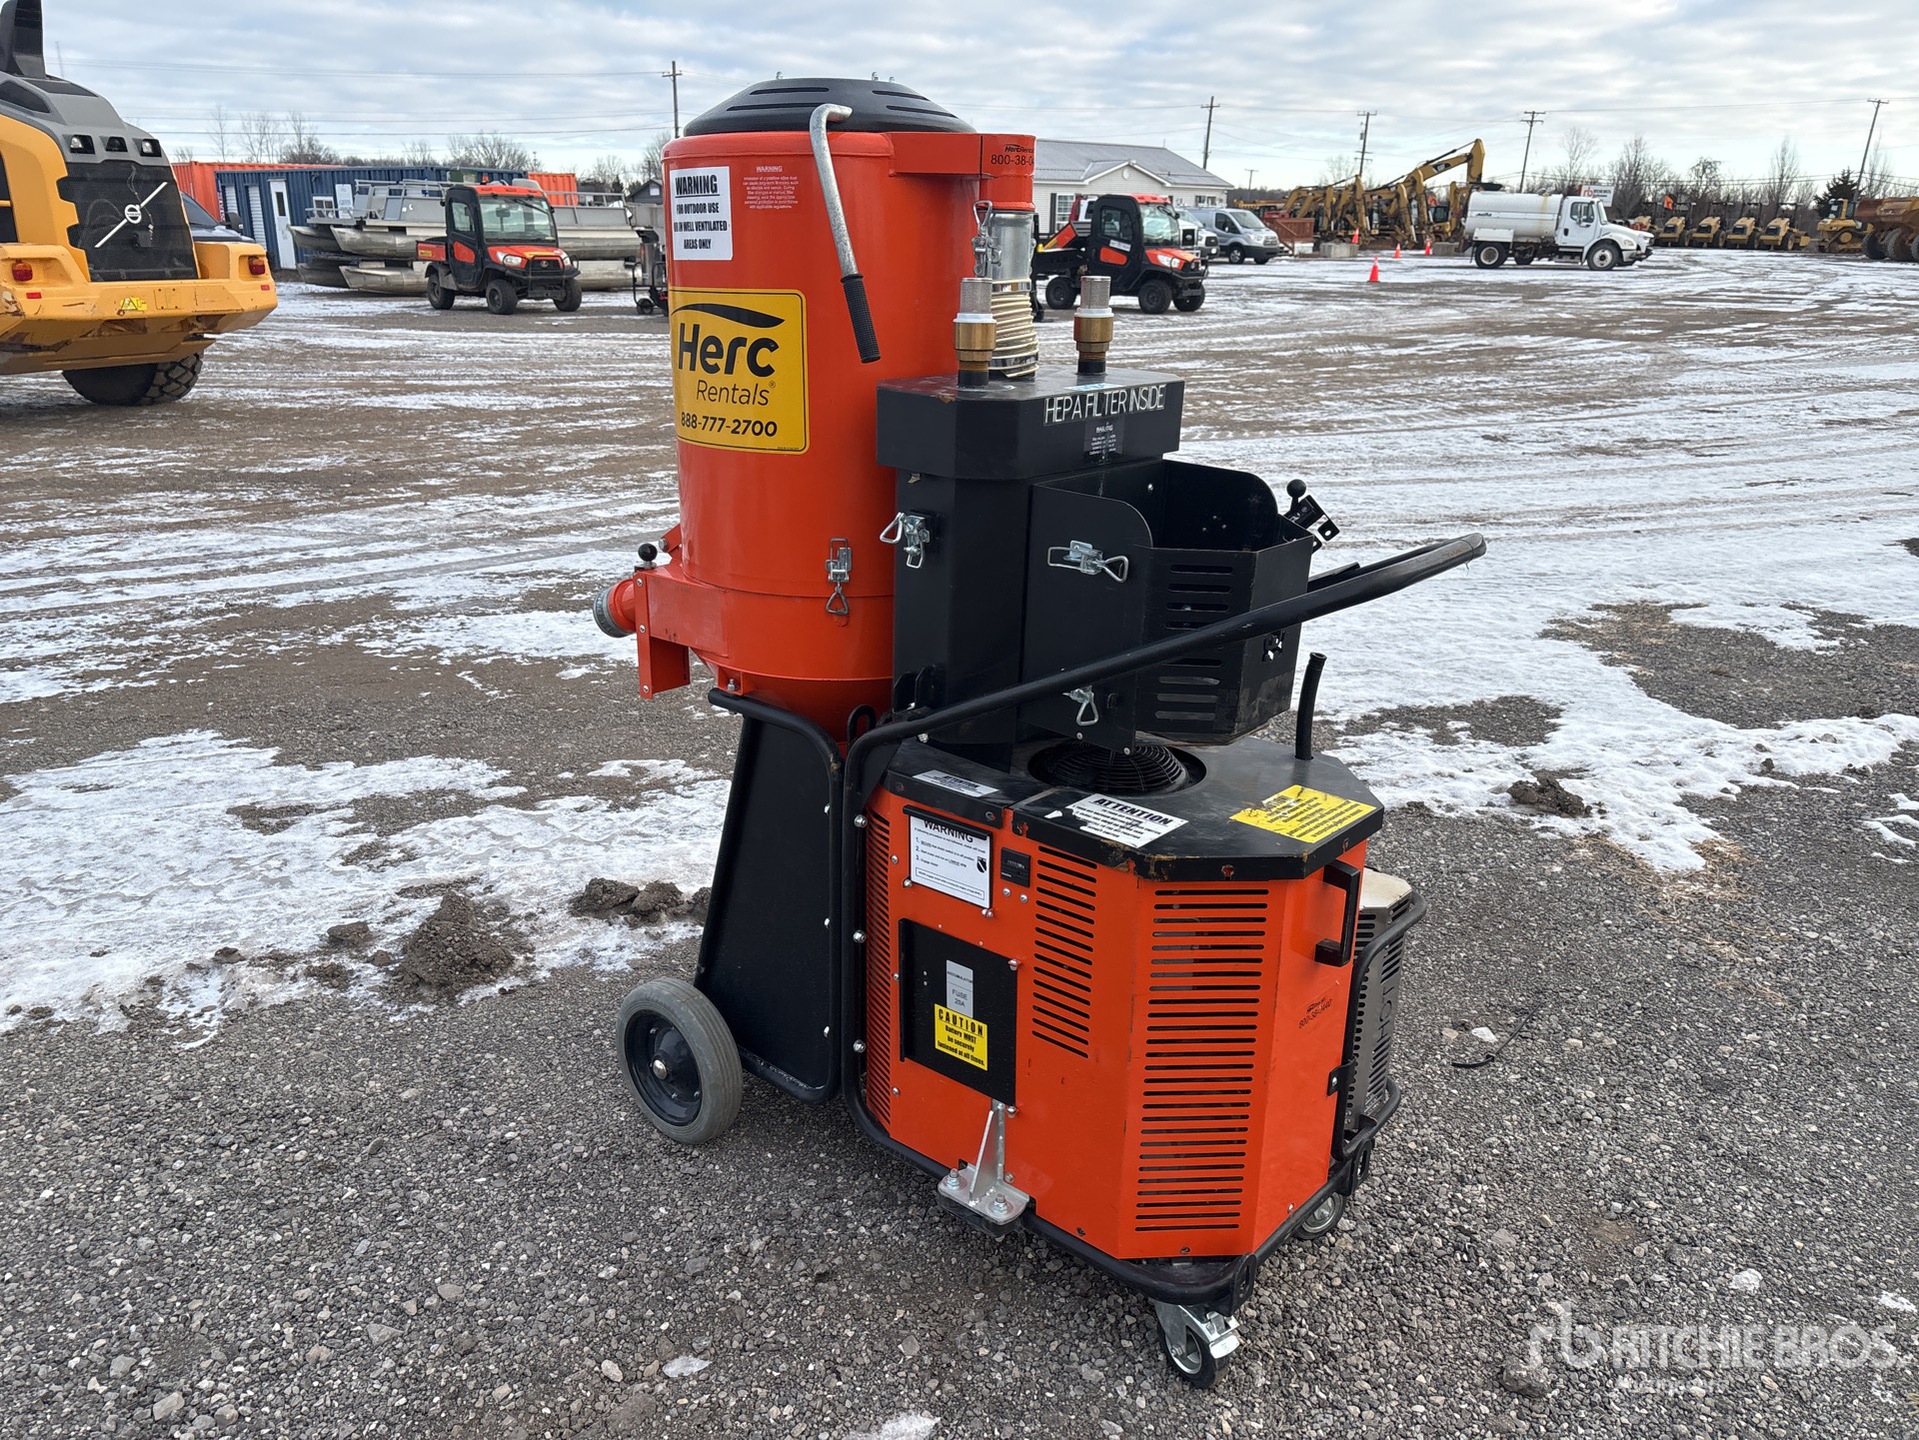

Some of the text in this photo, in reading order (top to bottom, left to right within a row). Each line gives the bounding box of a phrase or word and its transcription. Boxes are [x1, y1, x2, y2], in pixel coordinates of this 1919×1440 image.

[675, 175, 718, 195] WARNING
[684, 203, 707, 214] OUTDOOR
[708, 202, 719, 213] USE
[684, 221, 695, 232] WELL
[695, 221, 727, 231] VENTILATED
[684, 239, 711, 249] AREAS ONLY
[678, 323, 779, 377] Herc
[1045, 384, 1167, 423] HEPA FILTER INSIDE
[681, 412, 778, 437] 888-777-2700
[1093, 799, 1173, 824] ATTENTION
[923, 820, 973, 843] WARNING
[938, 1008, 983, 1036] CAUTION
[1377, 987, 1394, 1043] HOT
[945, 1024, 977, 1044] Battery MUST
[947, 1035, 974, 1053] be securely
[937, 1040, 958, 1054] fastened
